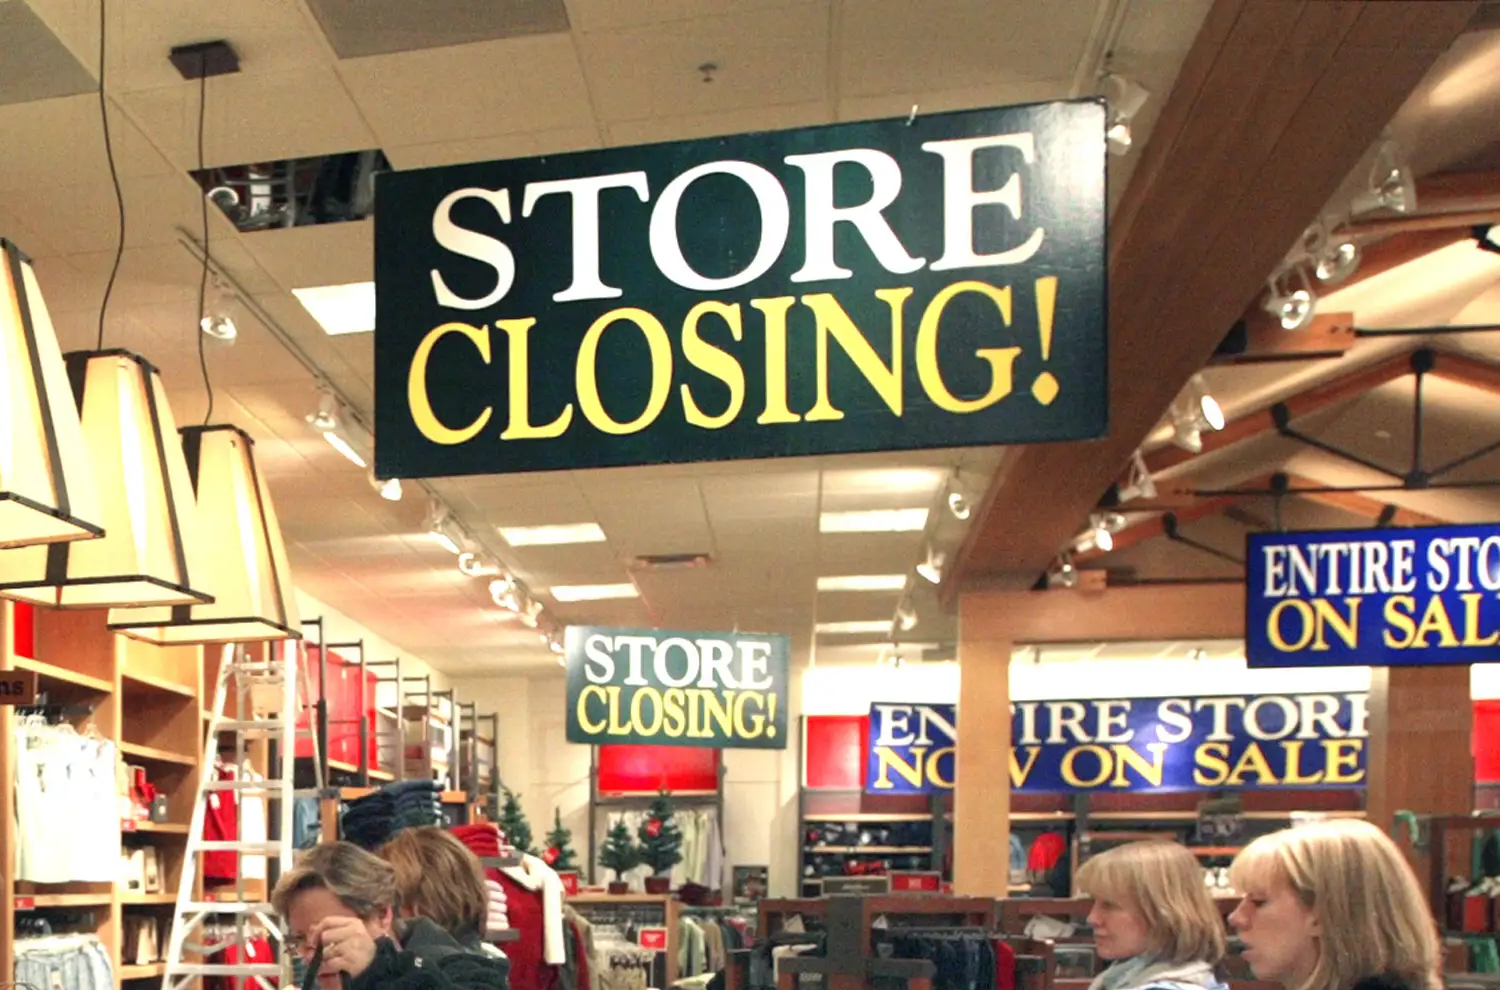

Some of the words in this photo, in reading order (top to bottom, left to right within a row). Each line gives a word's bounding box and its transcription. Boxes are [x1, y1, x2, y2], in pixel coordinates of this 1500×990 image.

[430, 132, 1046, 311] STORE
[407, 276, 1060, 445] CLOSING!
[1262, 540, 1417, 597] ENTIRE
[1267, 597, 1362, 652] ON
[1382, 593, 1500, 650] SAL
[584, 633, 774, 690] STORE
[576, 684, 778, 740] CLOSING!
[874, 700, 1135, 746] ENIRE
[1060, 743, 1169, 789] ON
[1192, 738, 1366, 787] SALE
